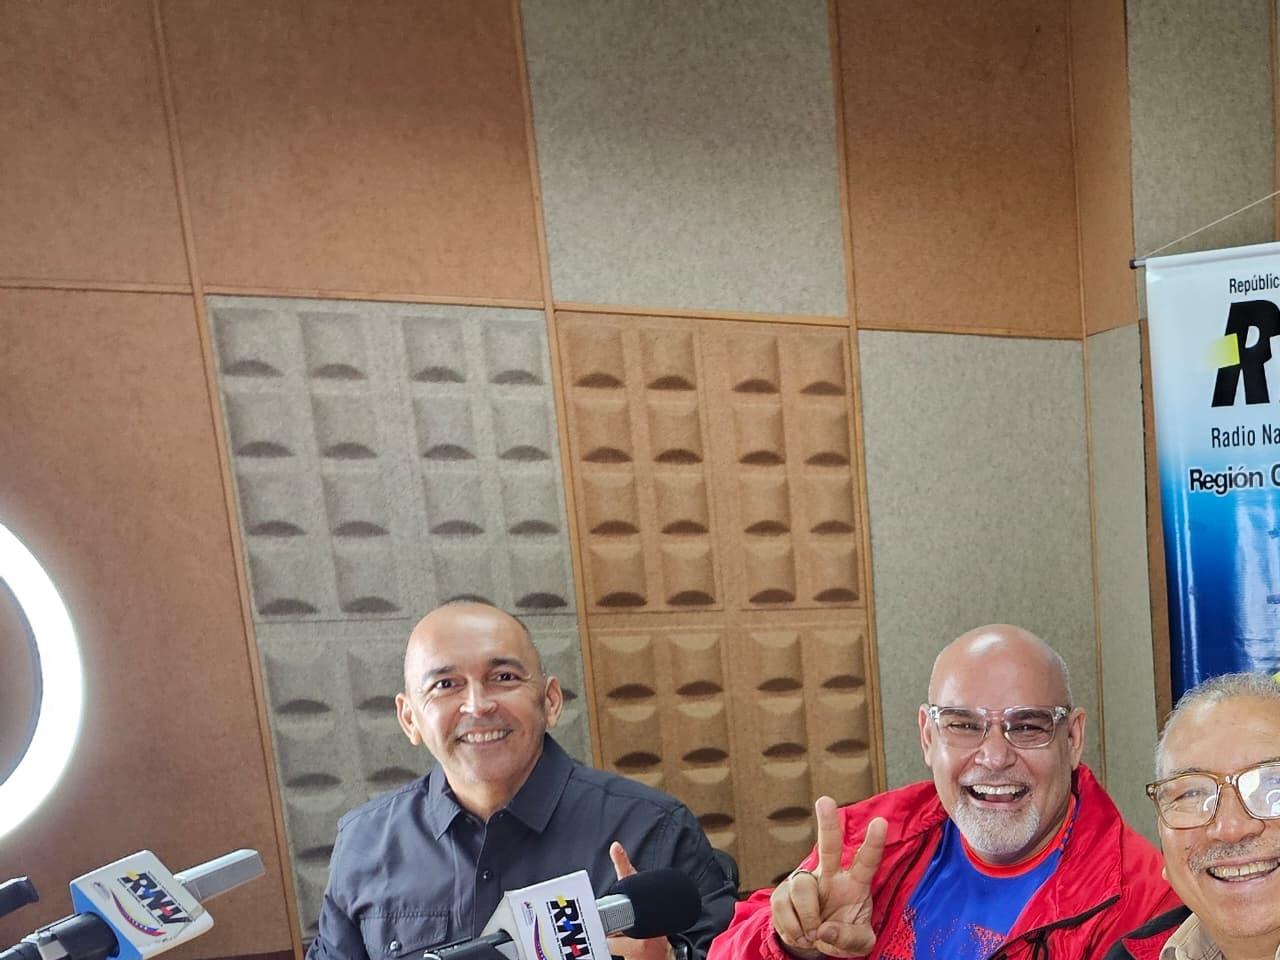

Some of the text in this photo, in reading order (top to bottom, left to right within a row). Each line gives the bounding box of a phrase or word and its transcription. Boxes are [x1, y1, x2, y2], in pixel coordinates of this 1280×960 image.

[1211, 426, 1256, 448] Radio
[1189, 465, 1264, 495] Región
[117, 870, 193, 925] RNV
